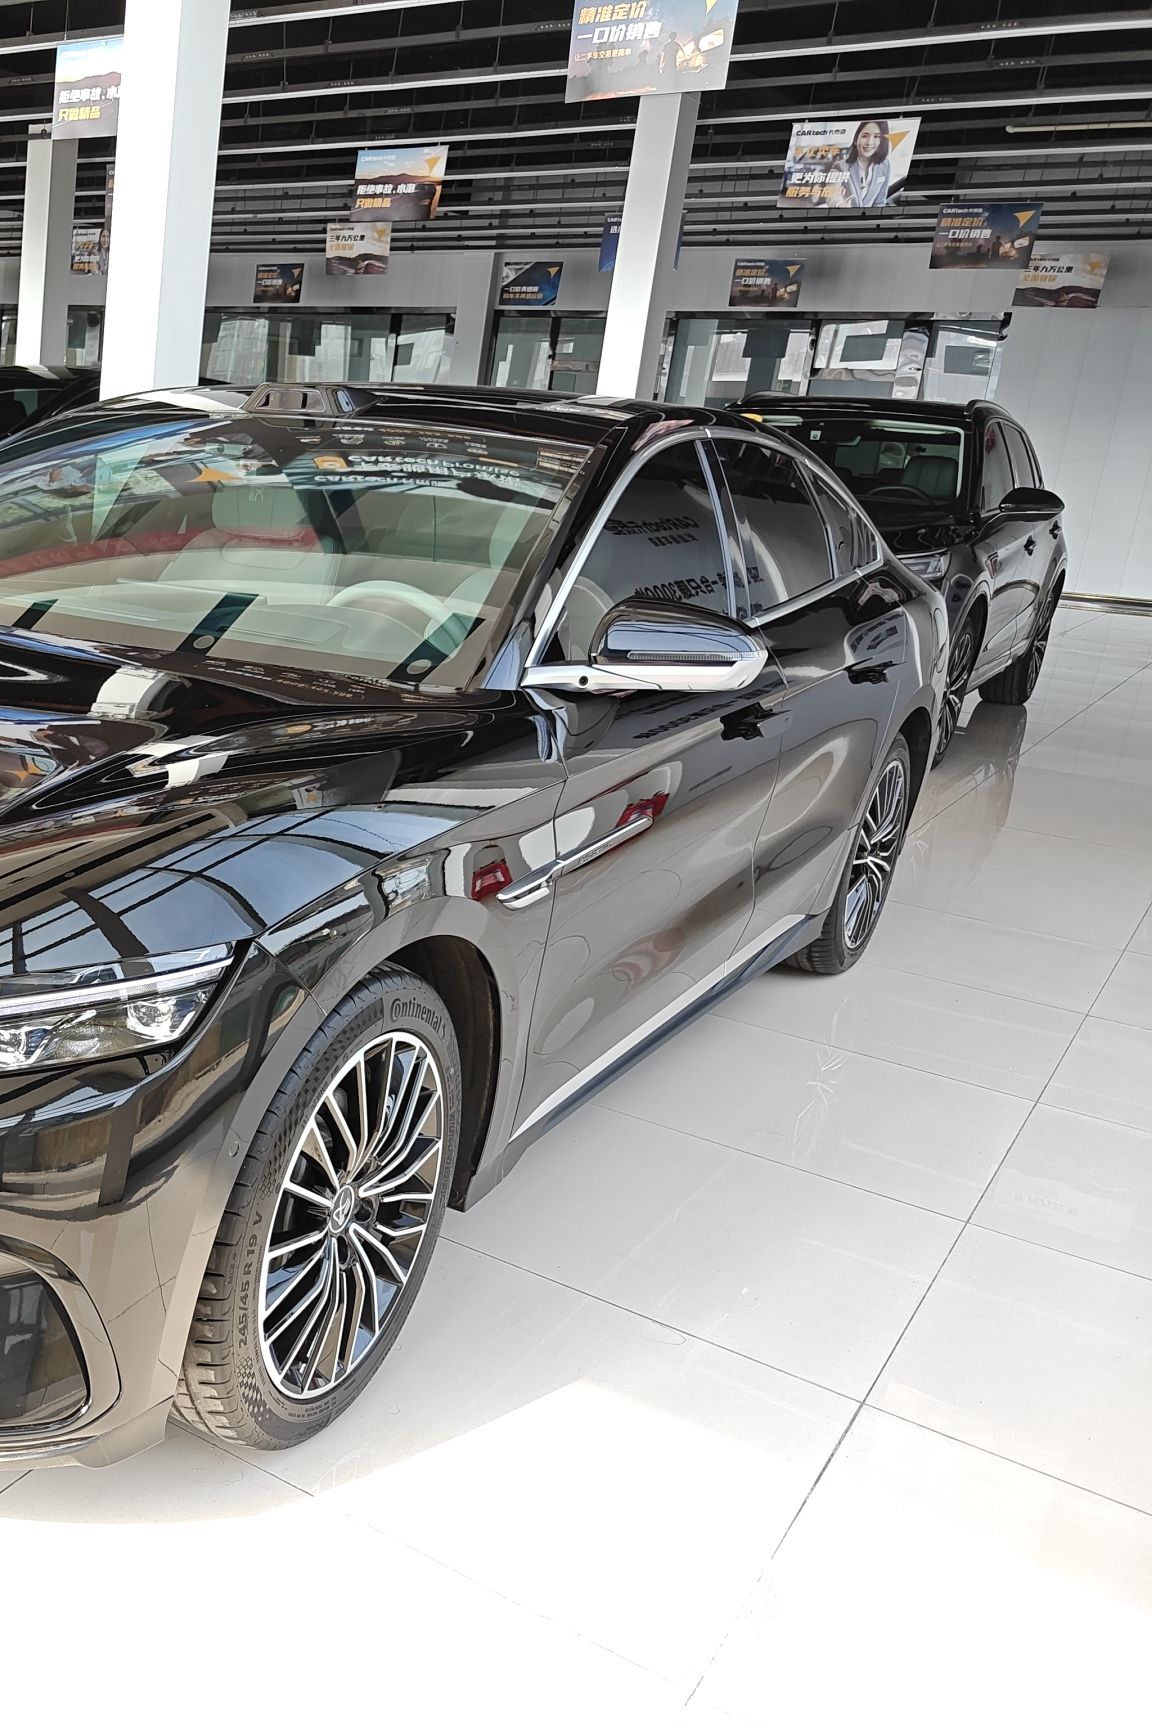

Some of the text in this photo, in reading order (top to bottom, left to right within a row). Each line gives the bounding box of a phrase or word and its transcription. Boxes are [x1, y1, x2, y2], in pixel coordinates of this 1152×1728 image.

[577, 21, 663, 44] 一口价销售
[796, 129, 827, 137] CARtech
[791, 171, 851, 184] 更为你提供
[390, 996, 443, 1034] Continental
[246, 1233, 258, 1258] 19
[242, 1261, 253, 1276] R
[237, 1280, 251, 1349] 245/45
